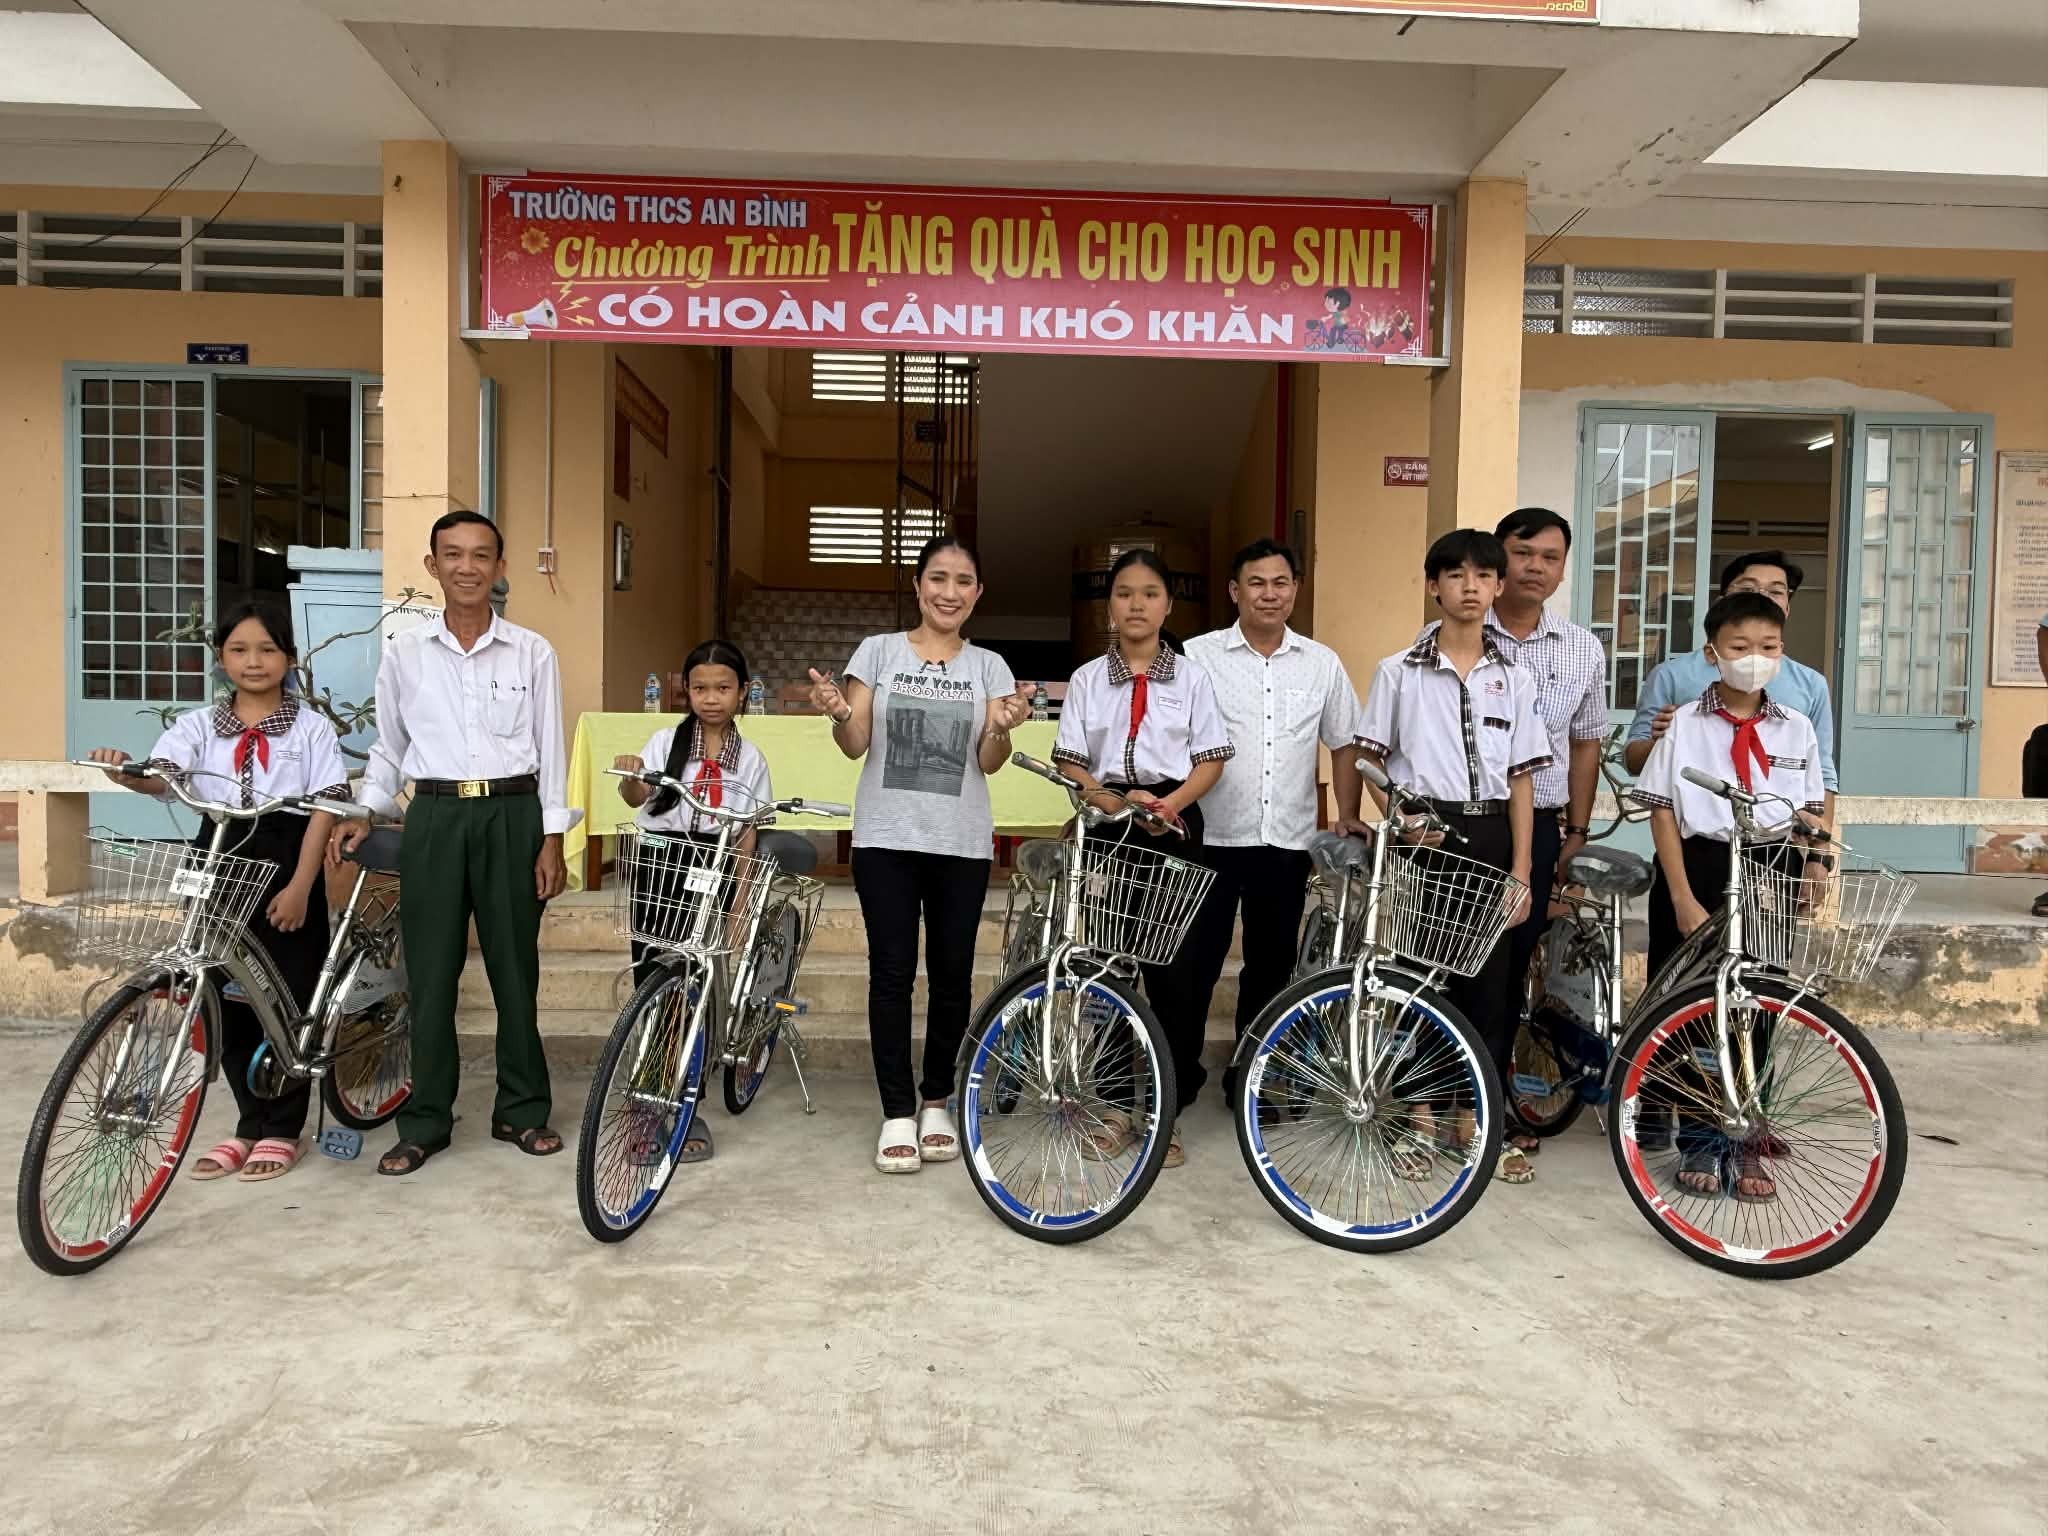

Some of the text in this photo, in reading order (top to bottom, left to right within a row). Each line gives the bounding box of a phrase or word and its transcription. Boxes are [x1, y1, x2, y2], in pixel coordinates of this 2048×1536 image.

[508, 185, 808, 229] TRƯỜNG THCS AN BÌNH
[553, 231, 832, 289] Chương Trình
[832, 200, 1401, 298] TẶNG QUÀ CHO HỌC SINH
[598, 286, 1294, 346] CÓ HOÀN CẢNH KHÓ KHĂN
[890, 682, 974, 700] BROOKLYN
[893, 672, 973, 691] NEW YORK
